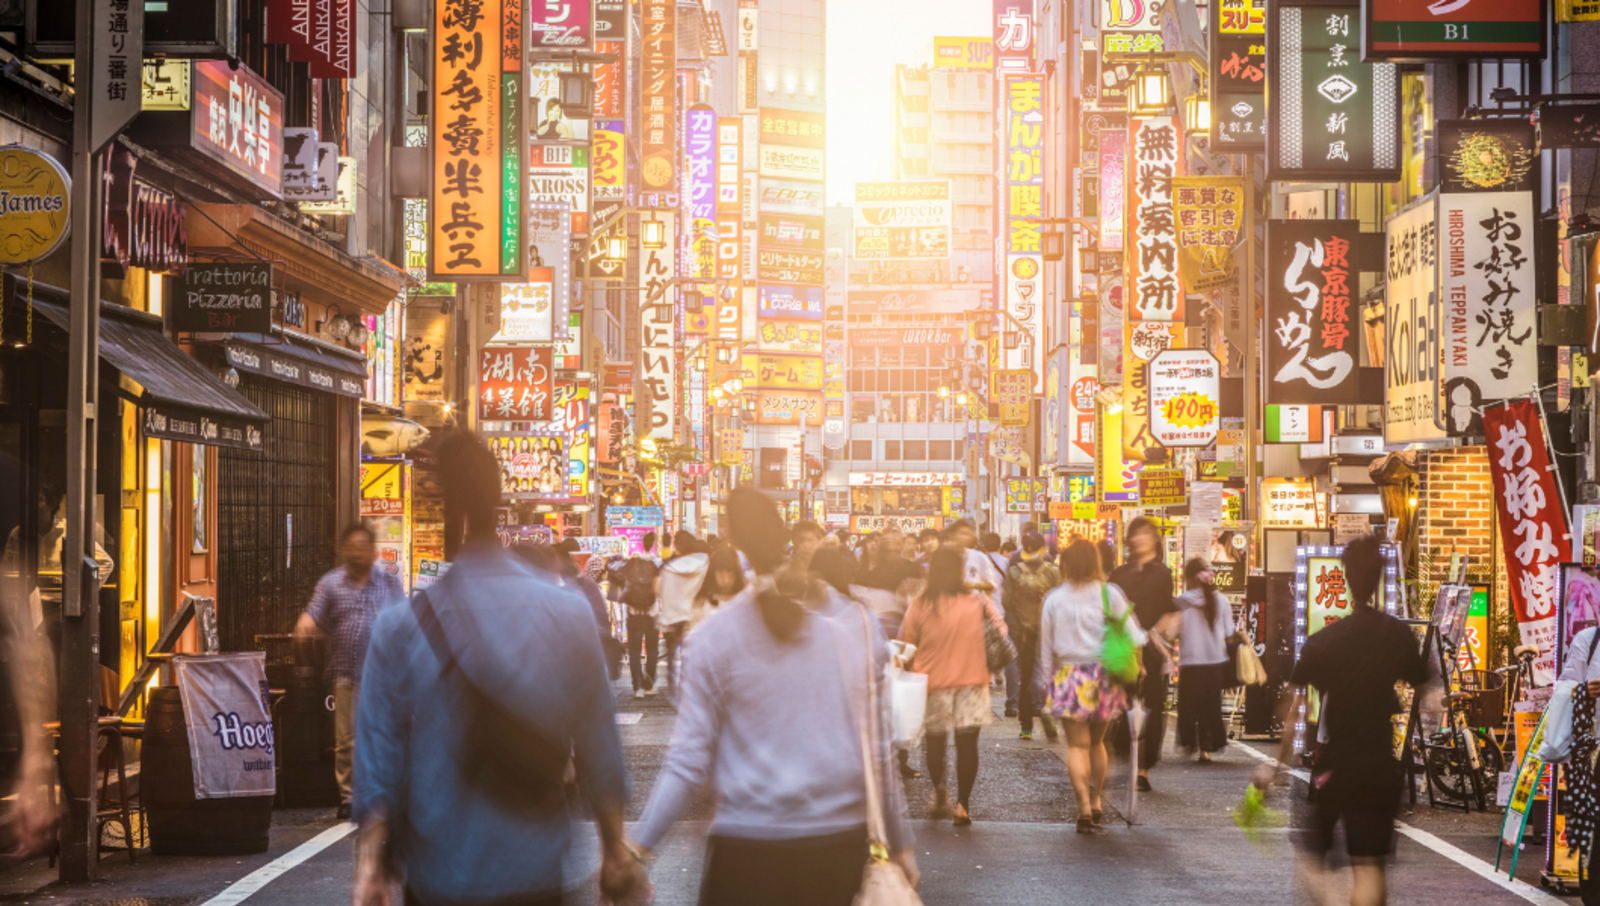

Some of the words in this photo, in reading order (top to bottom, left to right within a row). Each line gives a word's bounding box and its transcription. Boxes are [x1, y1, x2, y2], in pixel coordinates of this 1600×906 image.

[291, 0, 309, 37] AN
[1222, 11, 1264, 30] スリー
[1443, 23, 1470, 40] B1
[333, 0, 349, 73] ANKAK
[1325, 13, 1349, 67] 割烹
[650, 0, 666, 144] 室ダイニング居酒屋
[229, 74, 270, 175] 安楽亭
[762, 117, 823, 138] 全店営業中
[1325, 112, 1349, 162] 新風
[690, 110, 713, 200] カラオケ
[1008, 79, 1042, 253] まんが喫茶
[530, 178, 586, 195] XROSS
[1178, 187, 1237, 206] 悪質な
[1137, 124, 1177, 311] 無料案内所
[1179, 208, 1236, 227] 客引き
[1180, 229, 1237, 248] に注意
[1449, 209, 1465, 278] HIROSHIMA
[184, 266, 269, 287] Trattoria
[186, 287, 263, 310] Pizzeria
[1320, 235, 1350, 350] 東京豚骨
[1473, 207, 1532, 380] お好み焼き
[207, 311, 241, 329] Bar
[1132, 330, 1169, 349] 新宿
[482, 349, 548, 386] 湖南
[761, 365, 799, 383] ゲーム
[762, 397, 818, 410] メンズサウナ
[1167, 398, 1214, 419] 190円
[862, 473, 902, 485] コーヒー
[1495, 417, 1560, 619] お好み焼
[1315, 565, 1348, 609] 焼
